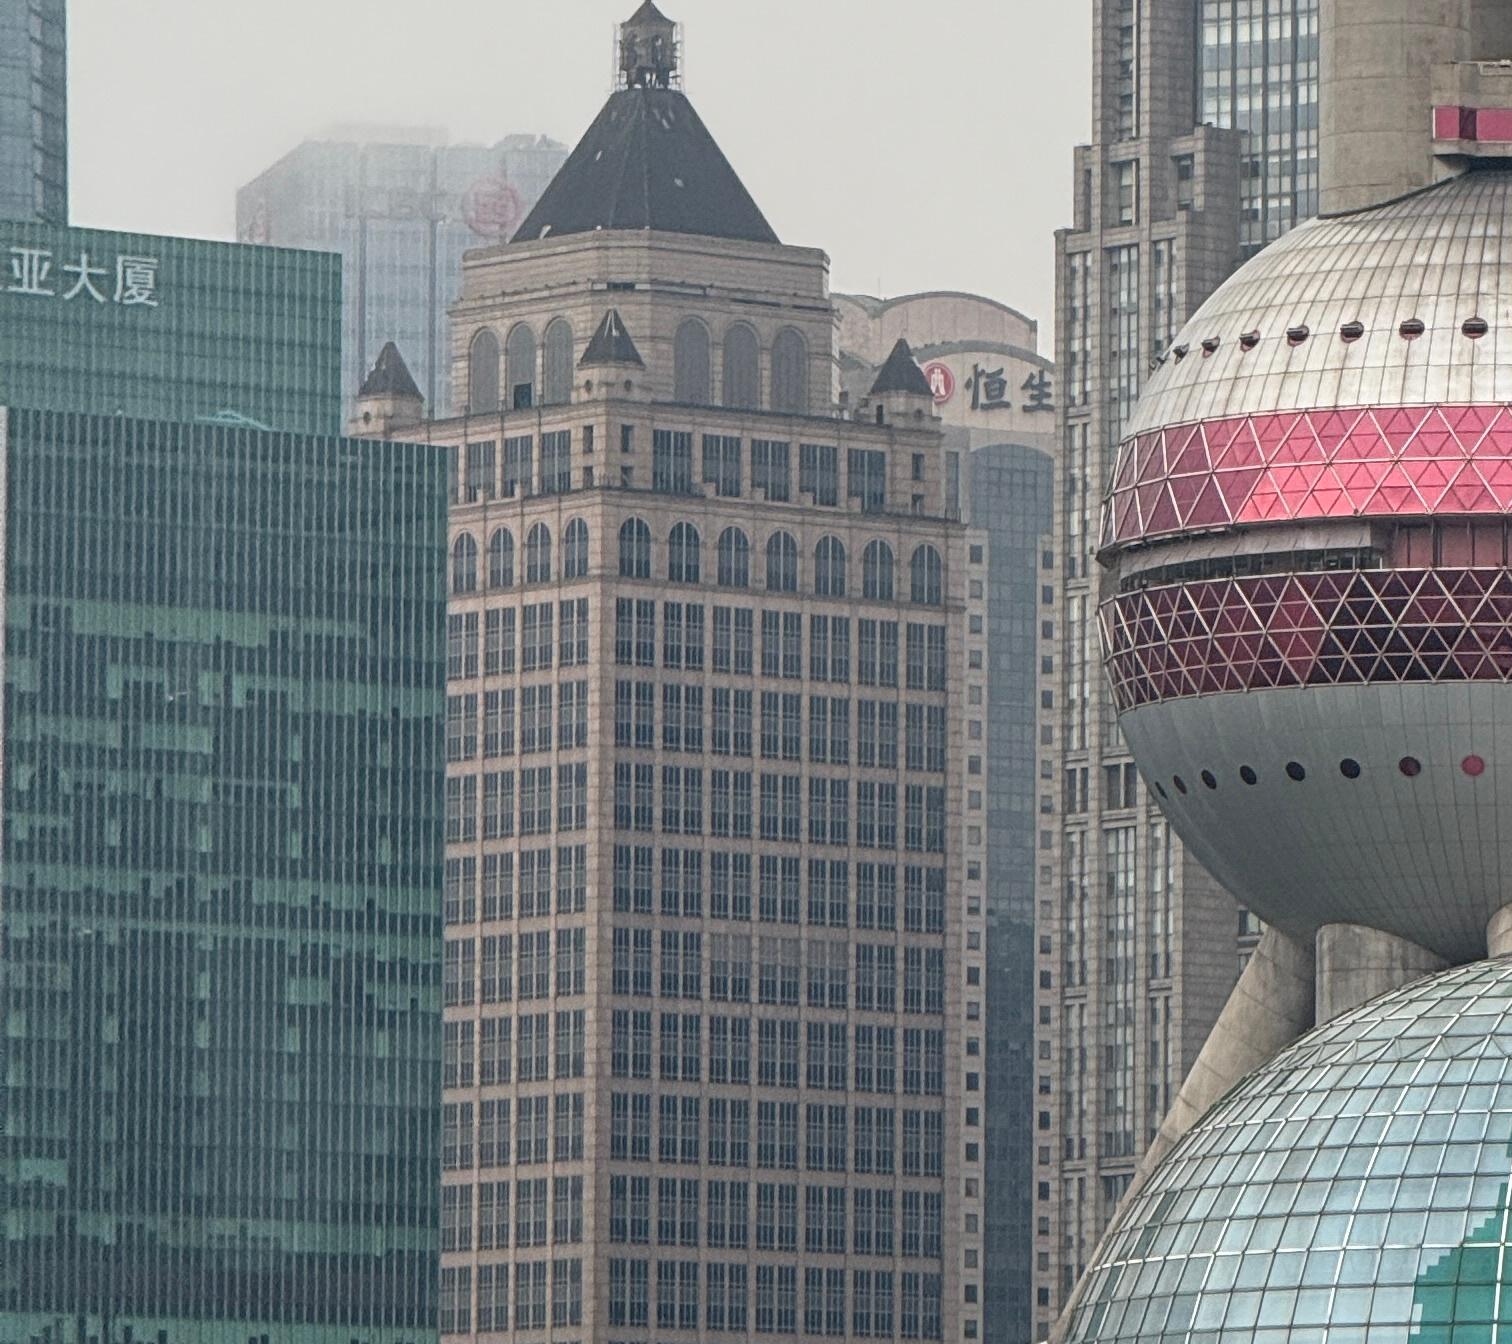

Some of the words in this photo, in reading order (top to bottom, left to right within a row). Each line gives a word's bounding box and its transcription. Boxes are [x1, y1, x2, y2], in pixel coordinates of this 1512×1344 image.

[0, 246, 158, 307] 亚大厦
[964, 362, 1055, 414] 恒生
